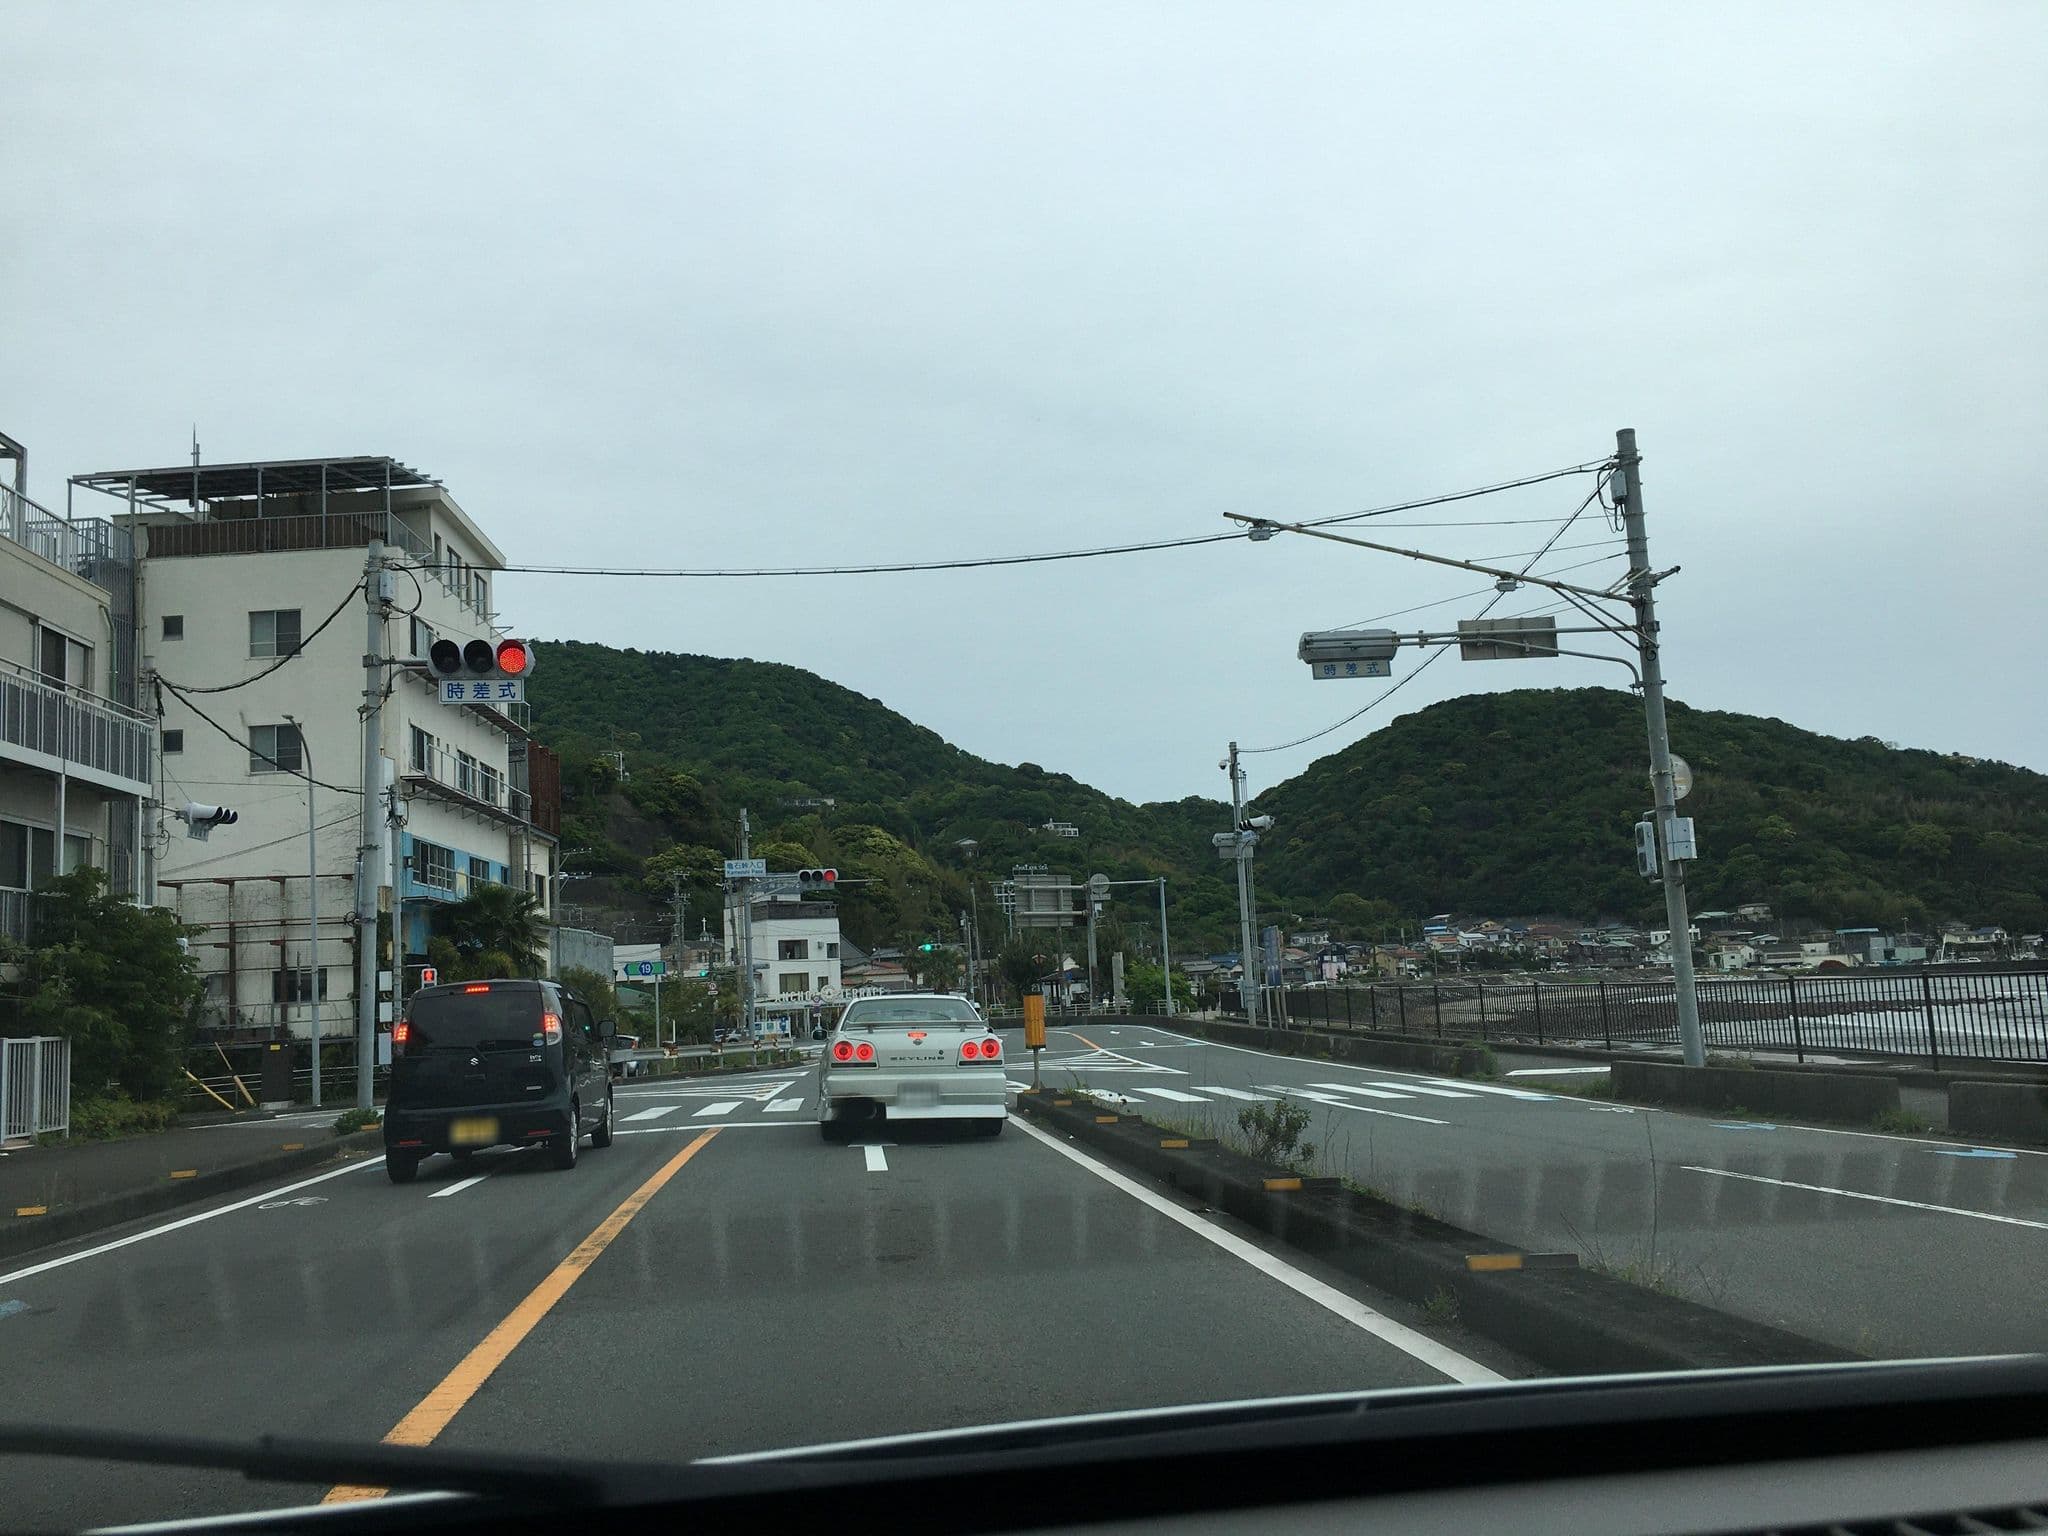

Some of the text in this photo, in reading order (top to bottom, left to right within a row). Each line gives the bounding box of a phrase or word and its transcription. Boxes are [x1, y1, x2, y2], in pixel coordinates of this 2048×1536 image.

[1323, 662, 1379, 676] 時差式
[447, 682, 516, 699] 時差式
[641, 964, 651, 974] 19
